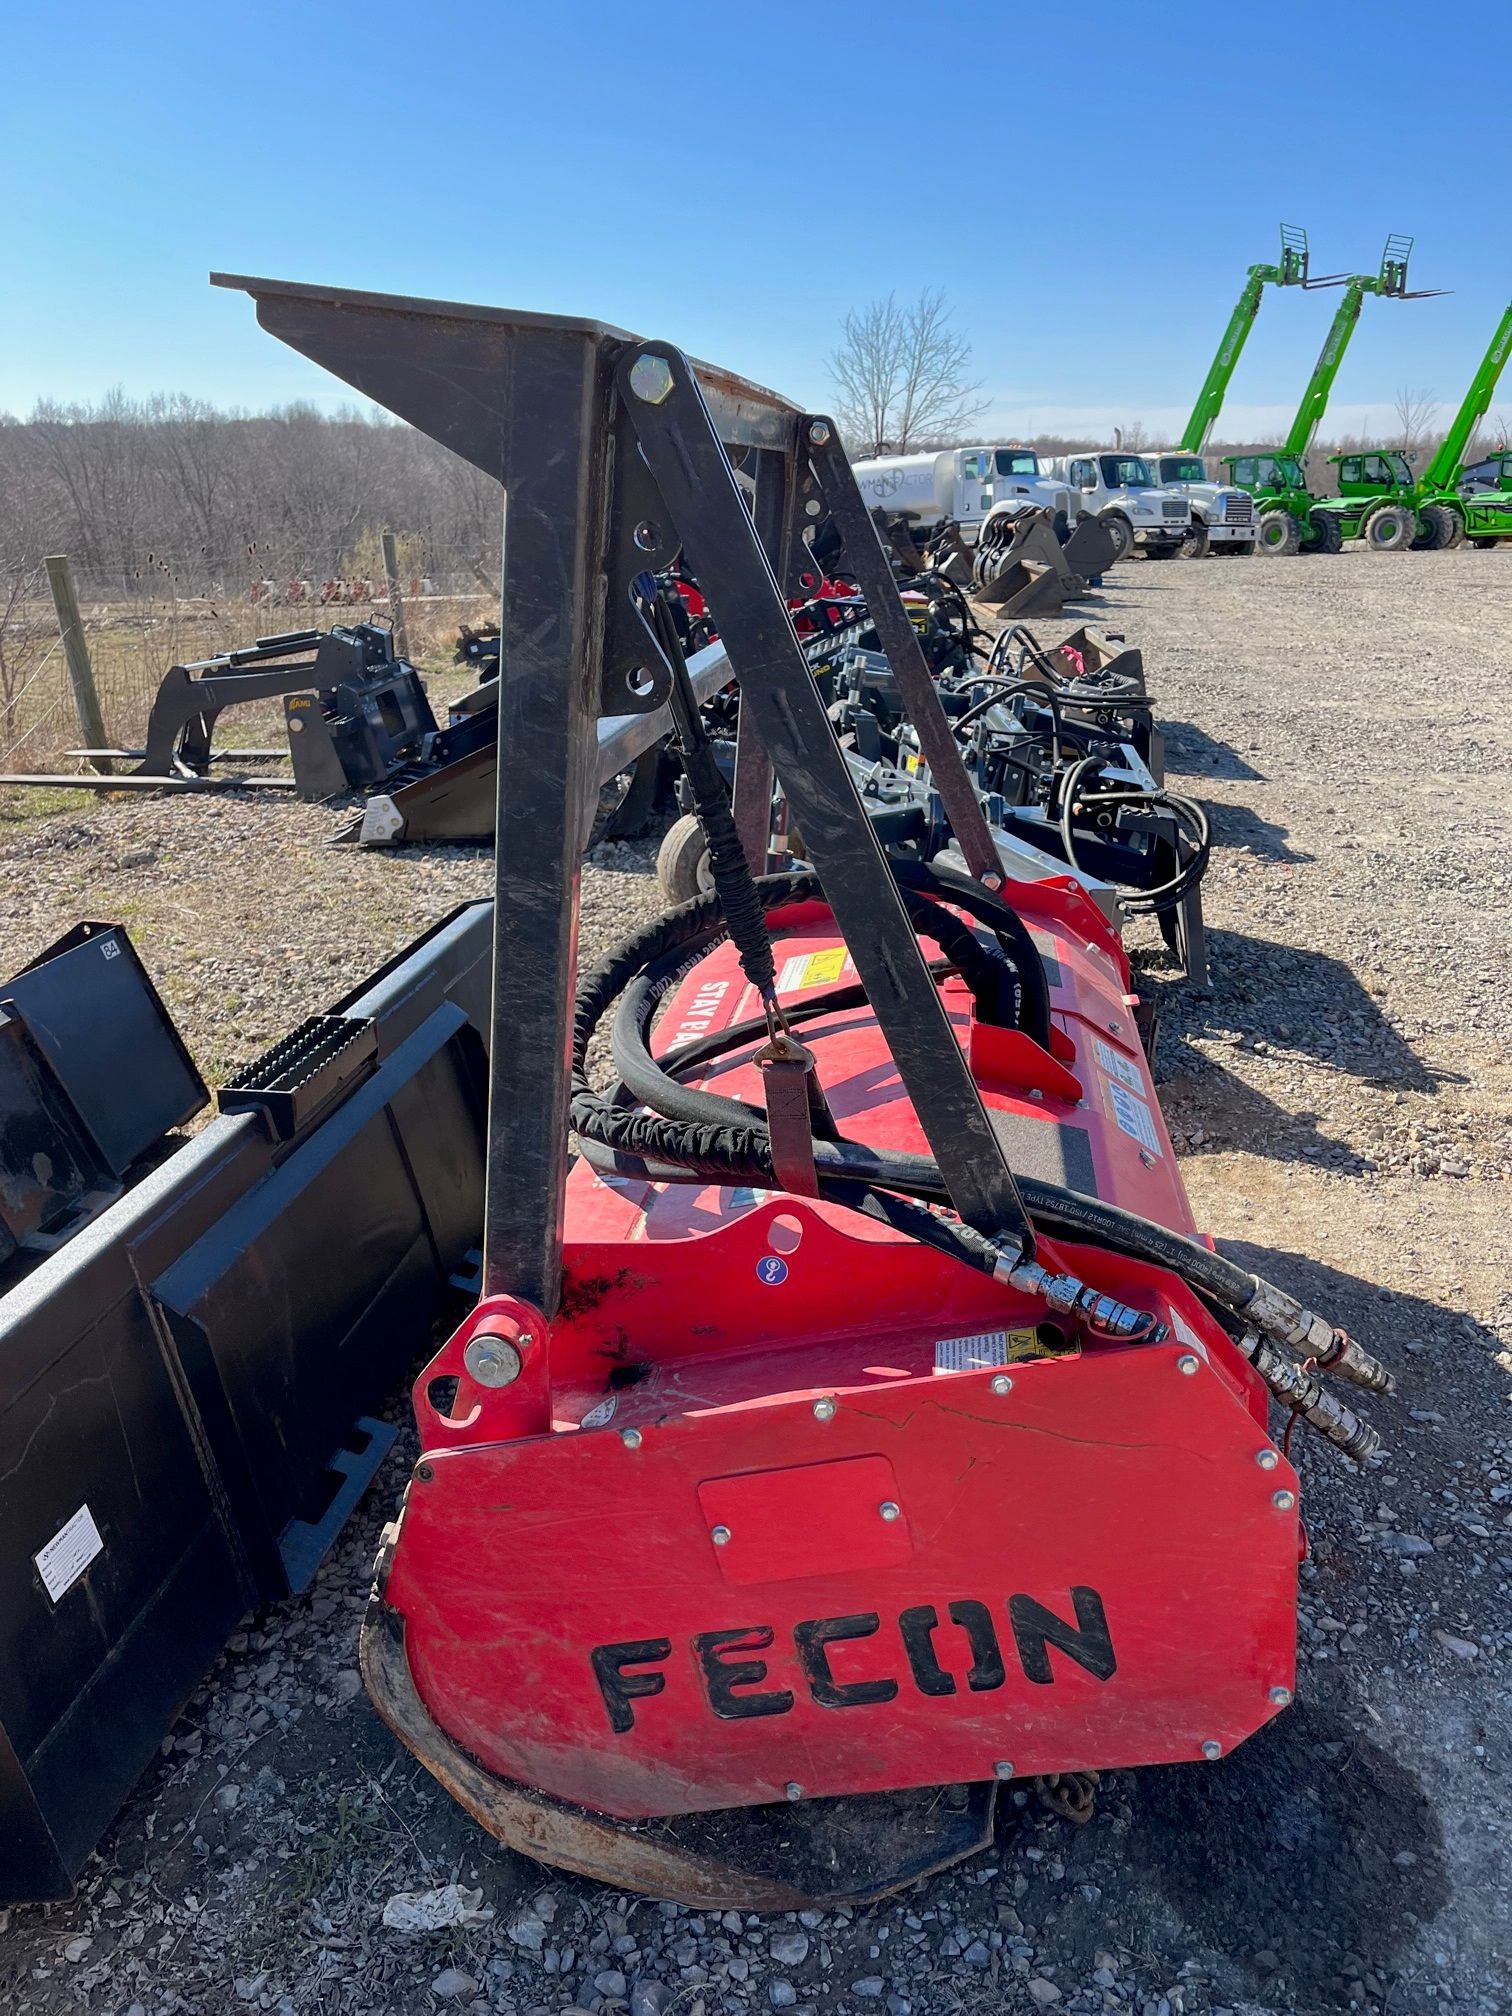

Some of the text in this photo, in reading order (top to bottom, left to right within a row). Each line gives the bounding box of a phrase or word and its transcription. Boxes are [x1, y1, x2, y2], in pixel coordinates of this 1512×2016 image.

[103, 942, 118, 958] 84
[687, 980, 730, 1017] STAY
[1025, 1193, 1044, 1205] TYPE
[1087, 1213, 1116, 1229] 100R12
[1116, 1224, 1130, 1235] SAE
[590, 1585, 1117, 1734] FECON
